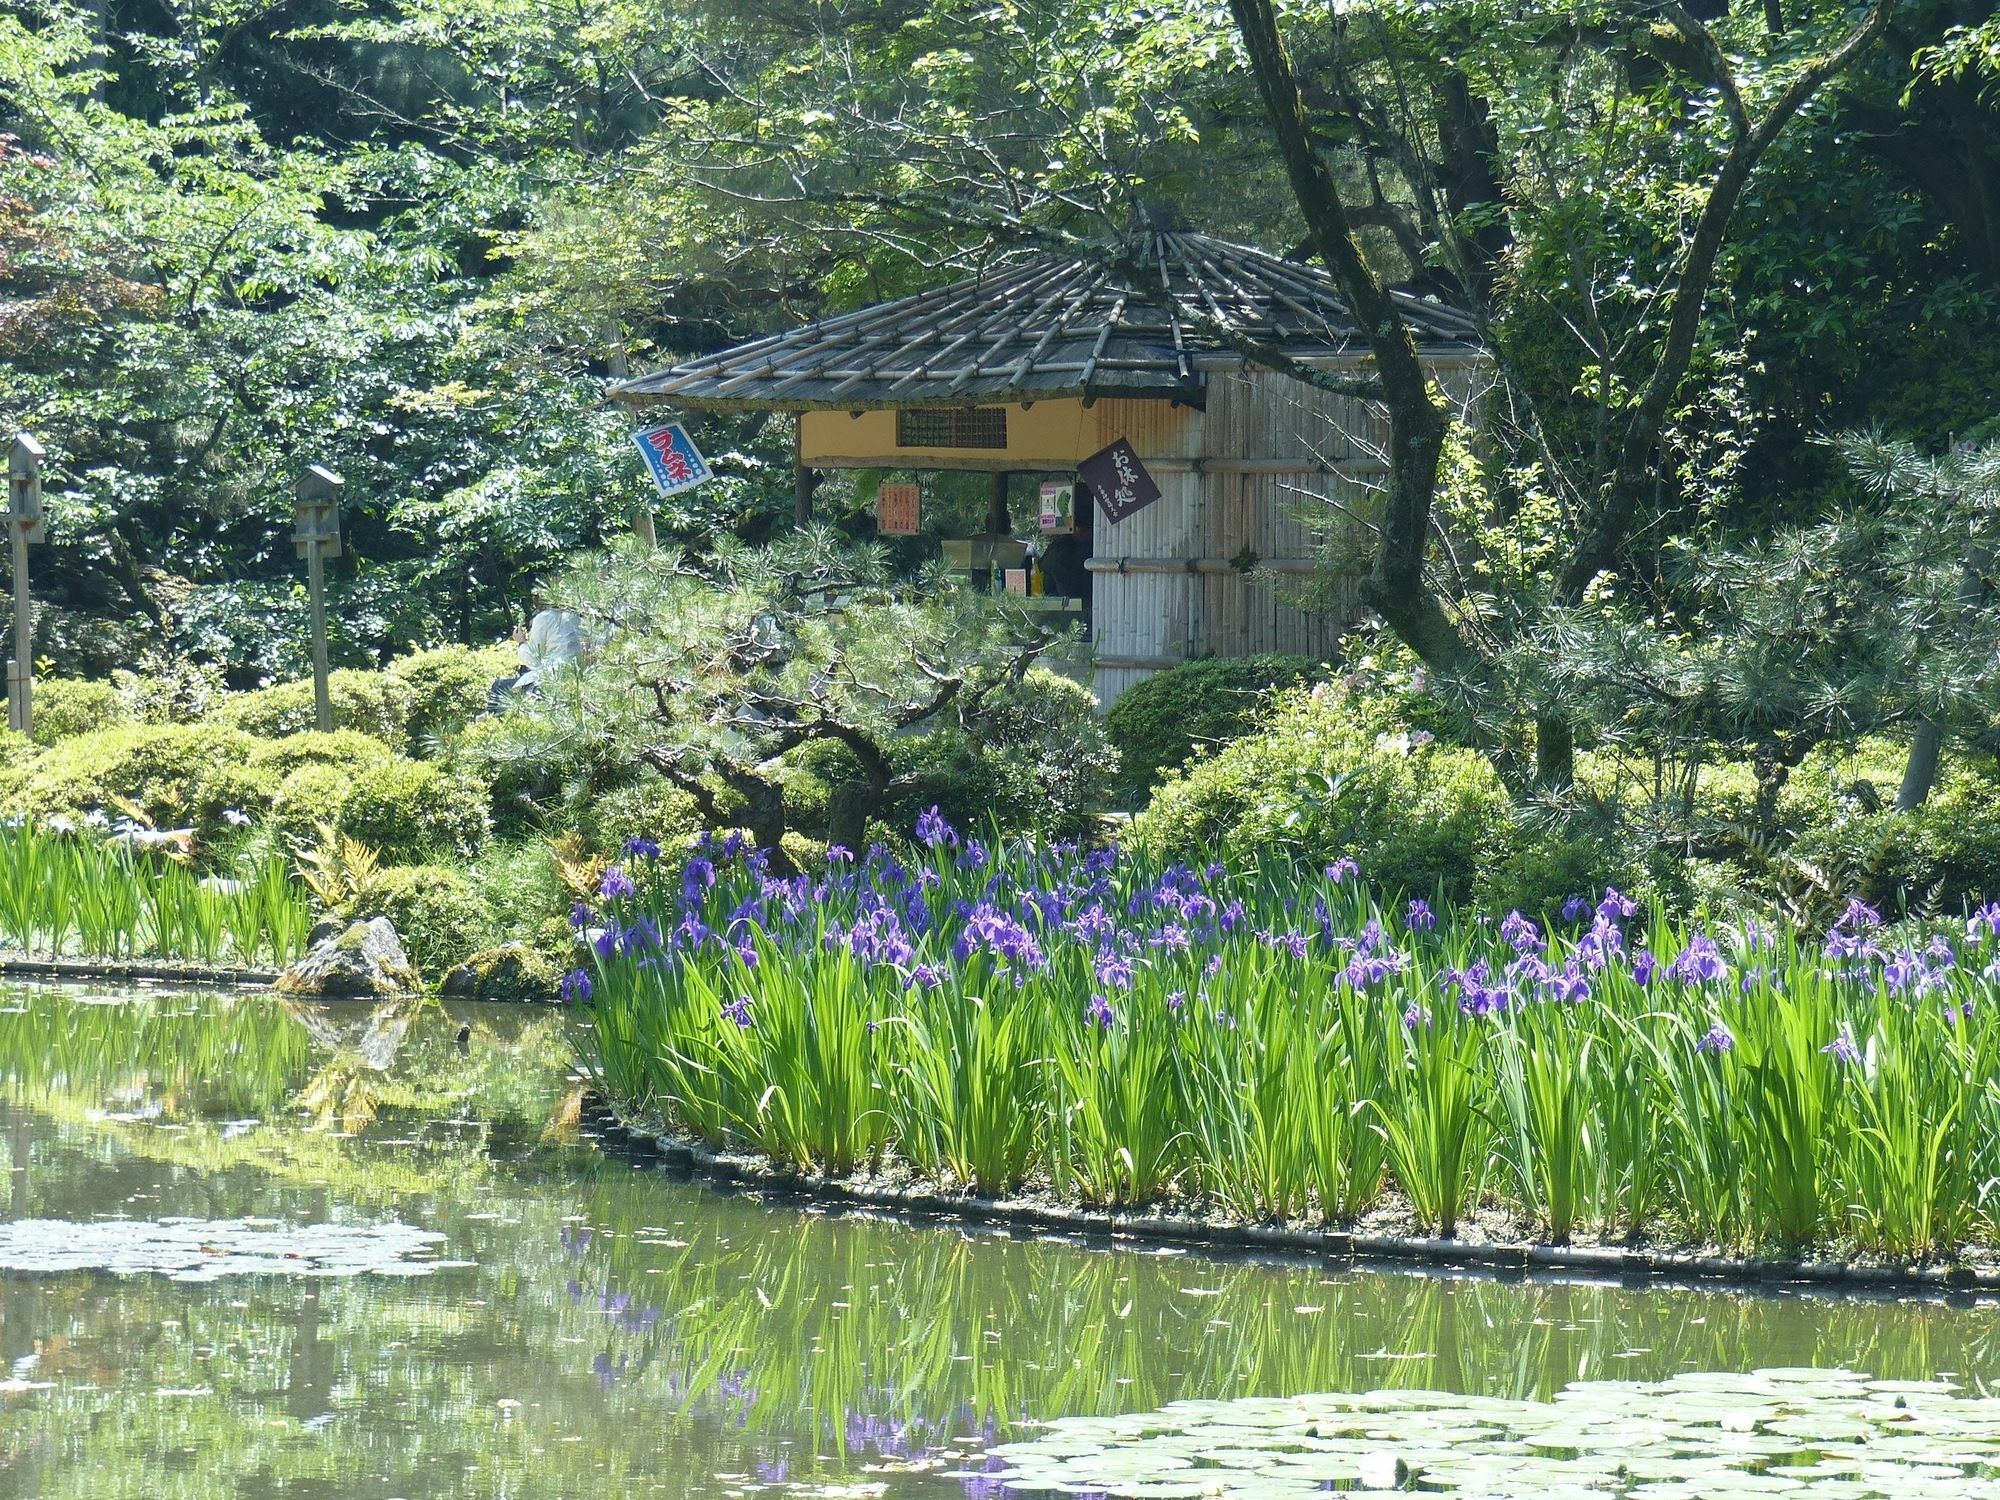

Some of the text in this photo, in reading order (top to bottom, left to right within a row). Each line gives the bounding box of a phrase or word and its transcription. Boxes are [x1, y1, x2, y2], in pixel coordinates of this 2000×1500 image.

[647, 430, 692, 481] ラムネ
[1112, 450, 1139, 507] お休処
